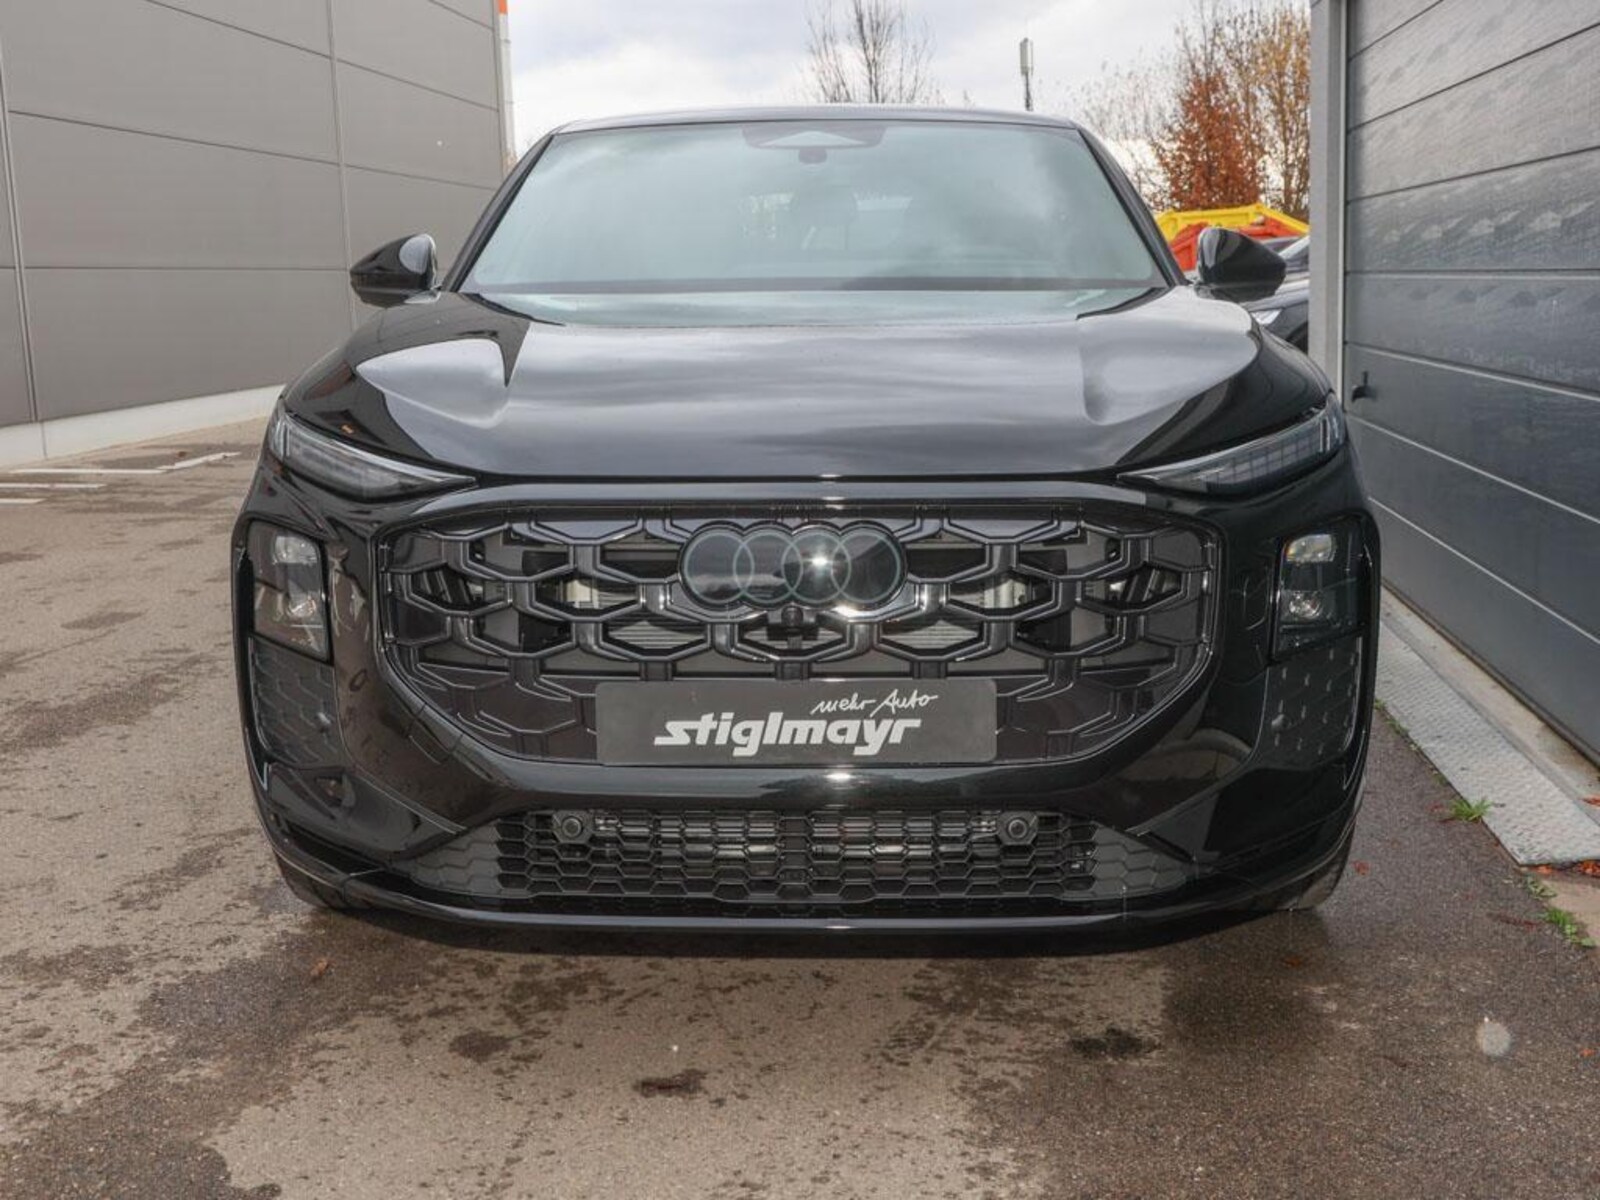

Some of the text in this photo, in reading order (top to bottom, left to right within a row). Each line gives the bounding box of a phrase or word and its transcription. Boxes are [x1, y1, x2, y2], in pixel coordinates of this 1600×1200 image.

[810, 689, 938, 717] mehr Auto
[653, 711, 922, 757] stiglmayr
